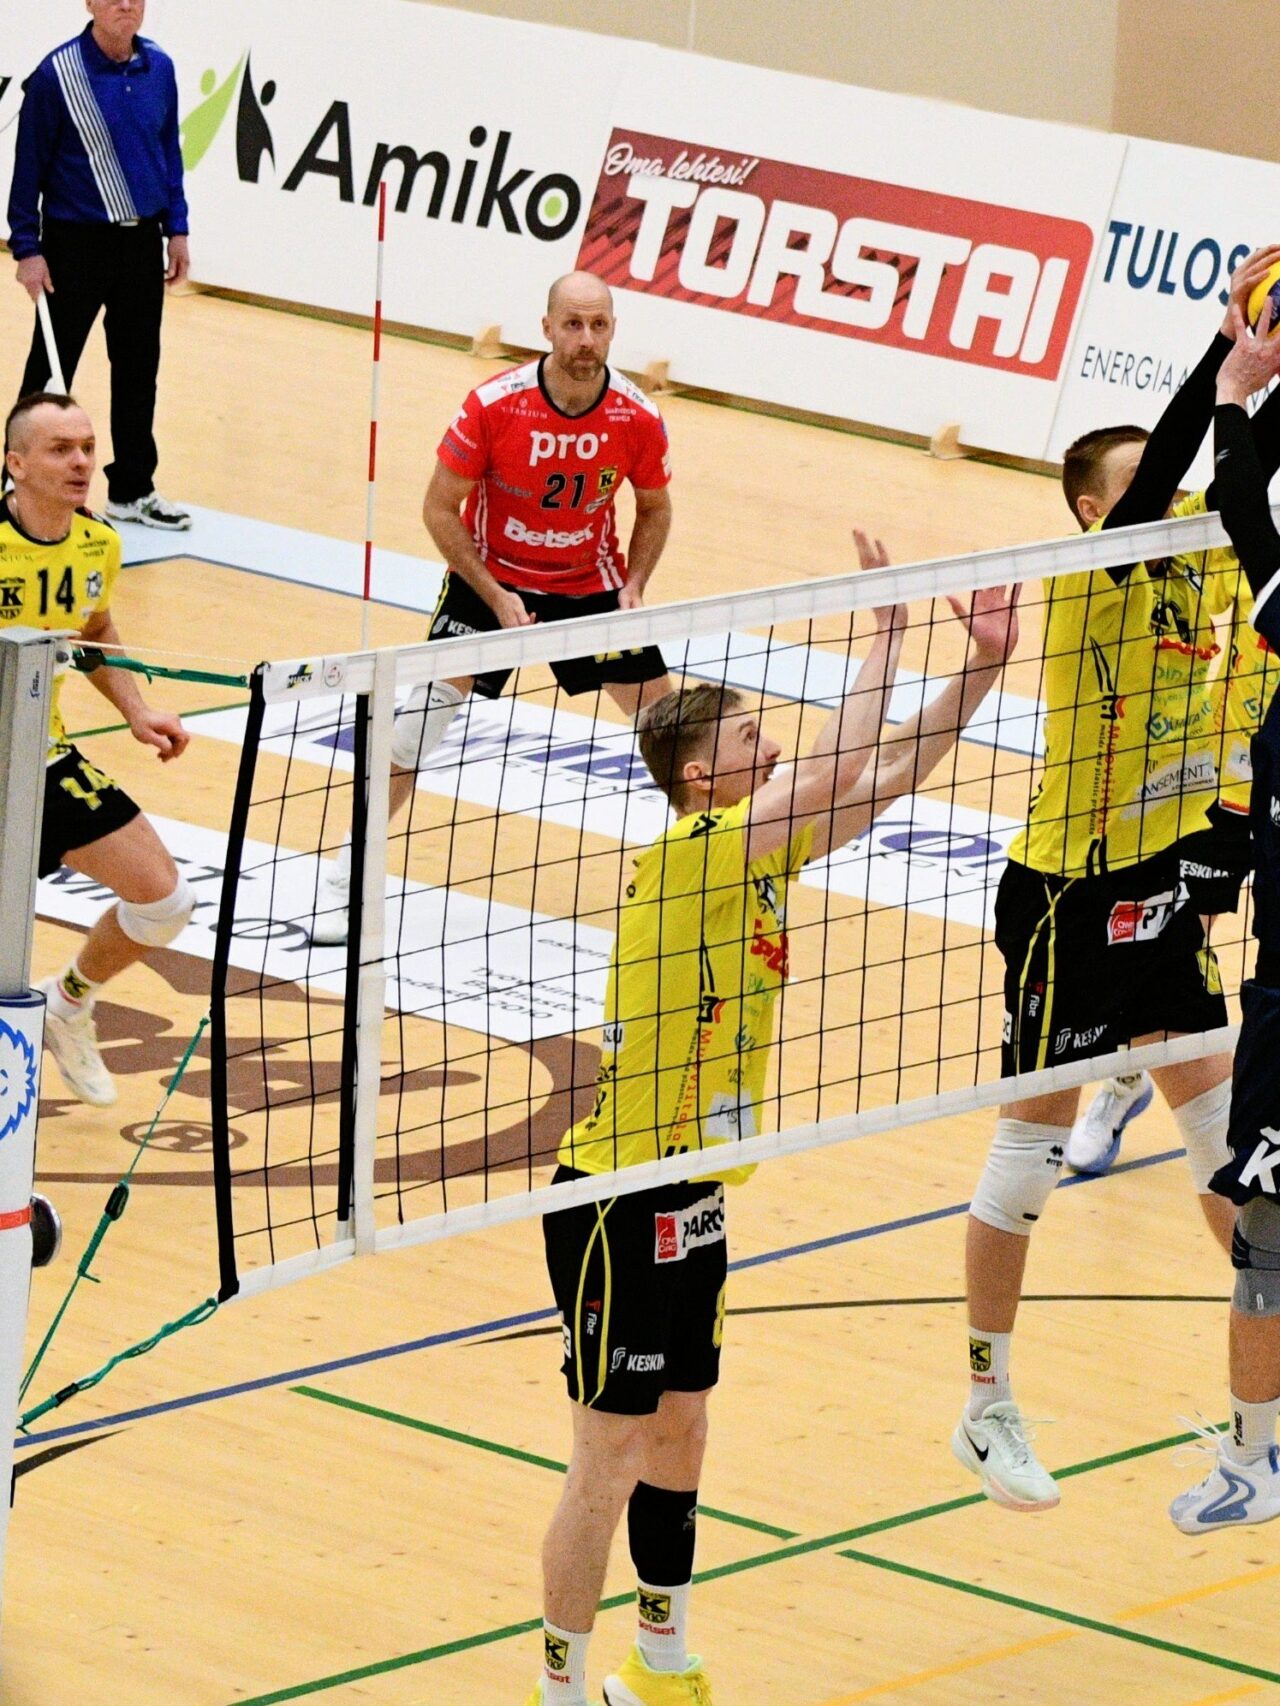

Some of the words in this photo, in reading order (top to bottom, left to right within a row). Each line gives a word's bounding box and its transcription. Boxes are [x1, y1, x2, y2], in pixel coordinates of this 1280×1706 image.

[282, 101, 581, 241] Amiko
[604, 142, 665, 177] Oma
[663, 150, 760, 185] lehtesi!
[625, 174, 1071, 364] TORSTAI
[539, 472, 588, 511] 21
[37, 565, 76, 616] 14
